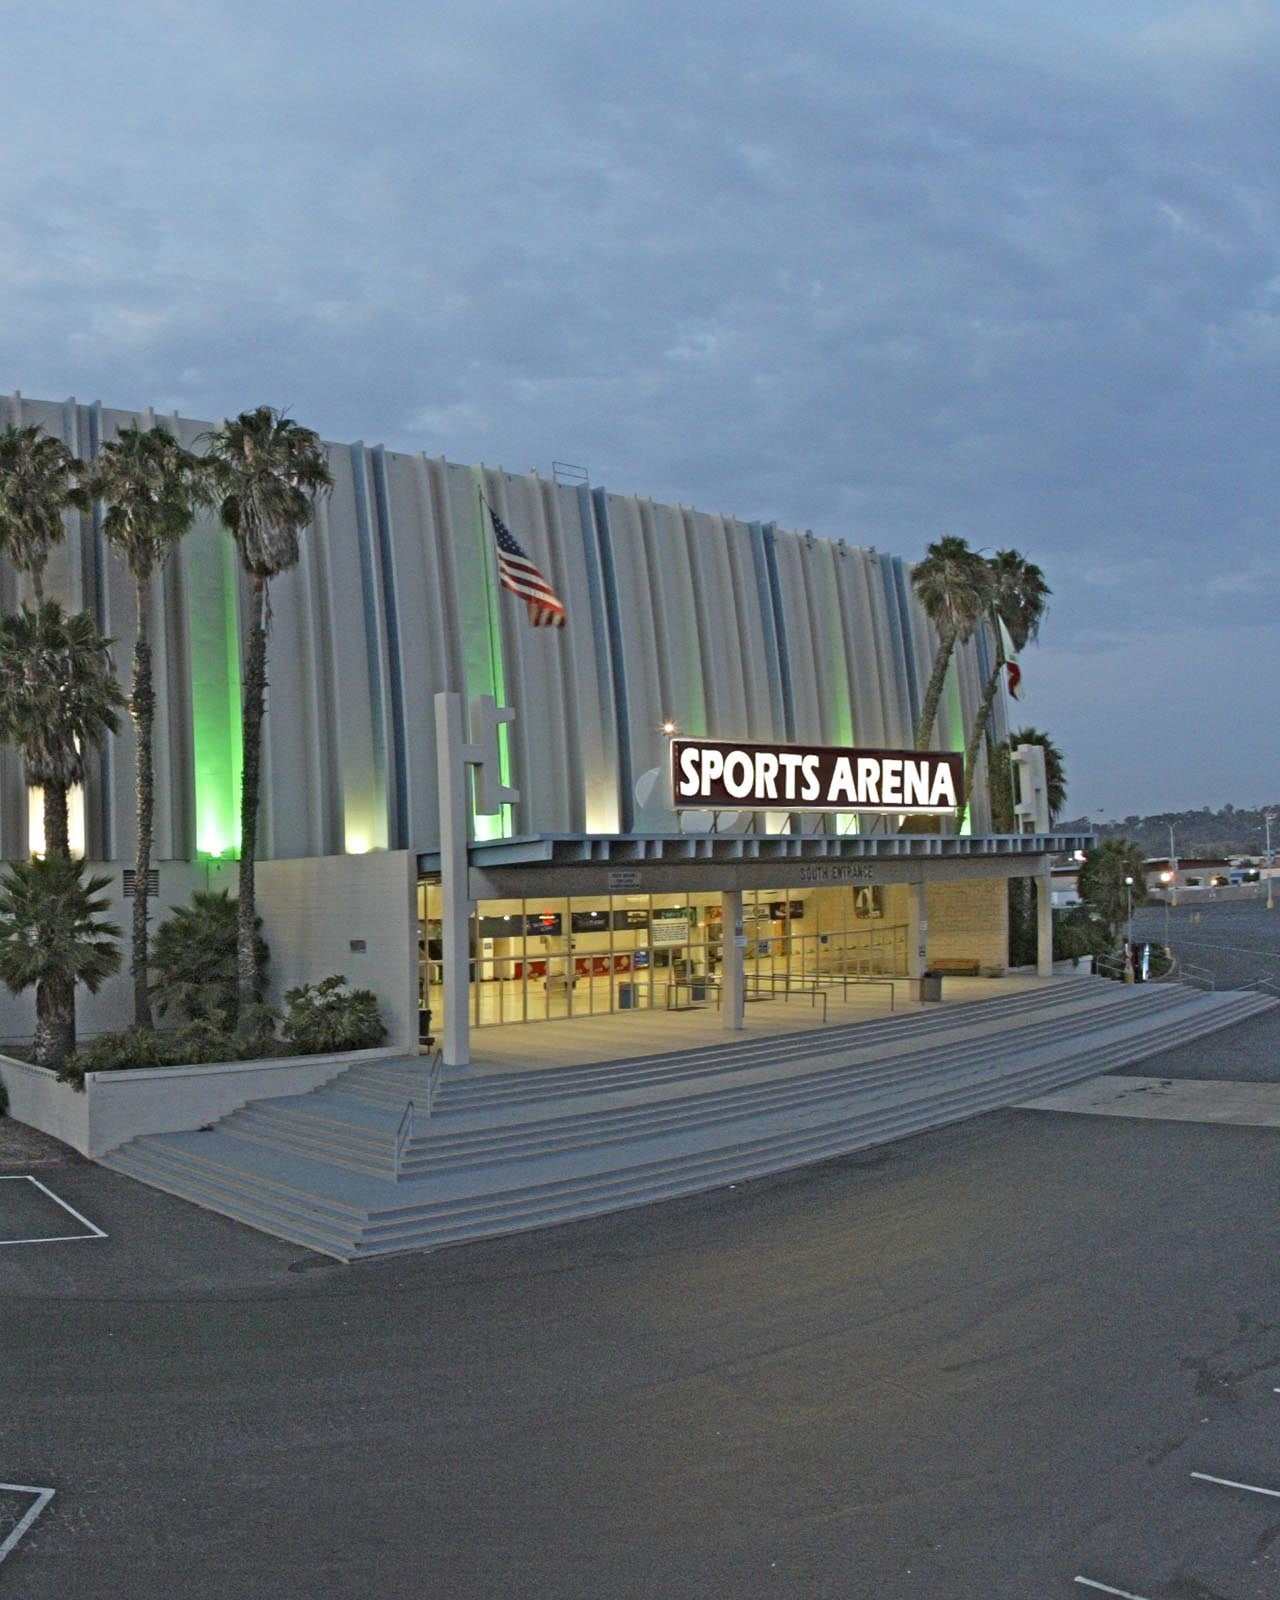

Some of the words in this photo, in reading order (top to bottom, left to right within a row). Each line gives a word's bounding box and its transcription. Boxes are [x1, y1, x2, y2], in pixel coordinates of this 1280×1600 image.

[680, 748, 820, 800] SPORTS
[826, 756, 957, 806] ARENA
[800, 865, 829, 881] SOUTH
[832, 864, 873, 880] ENTRANCE
